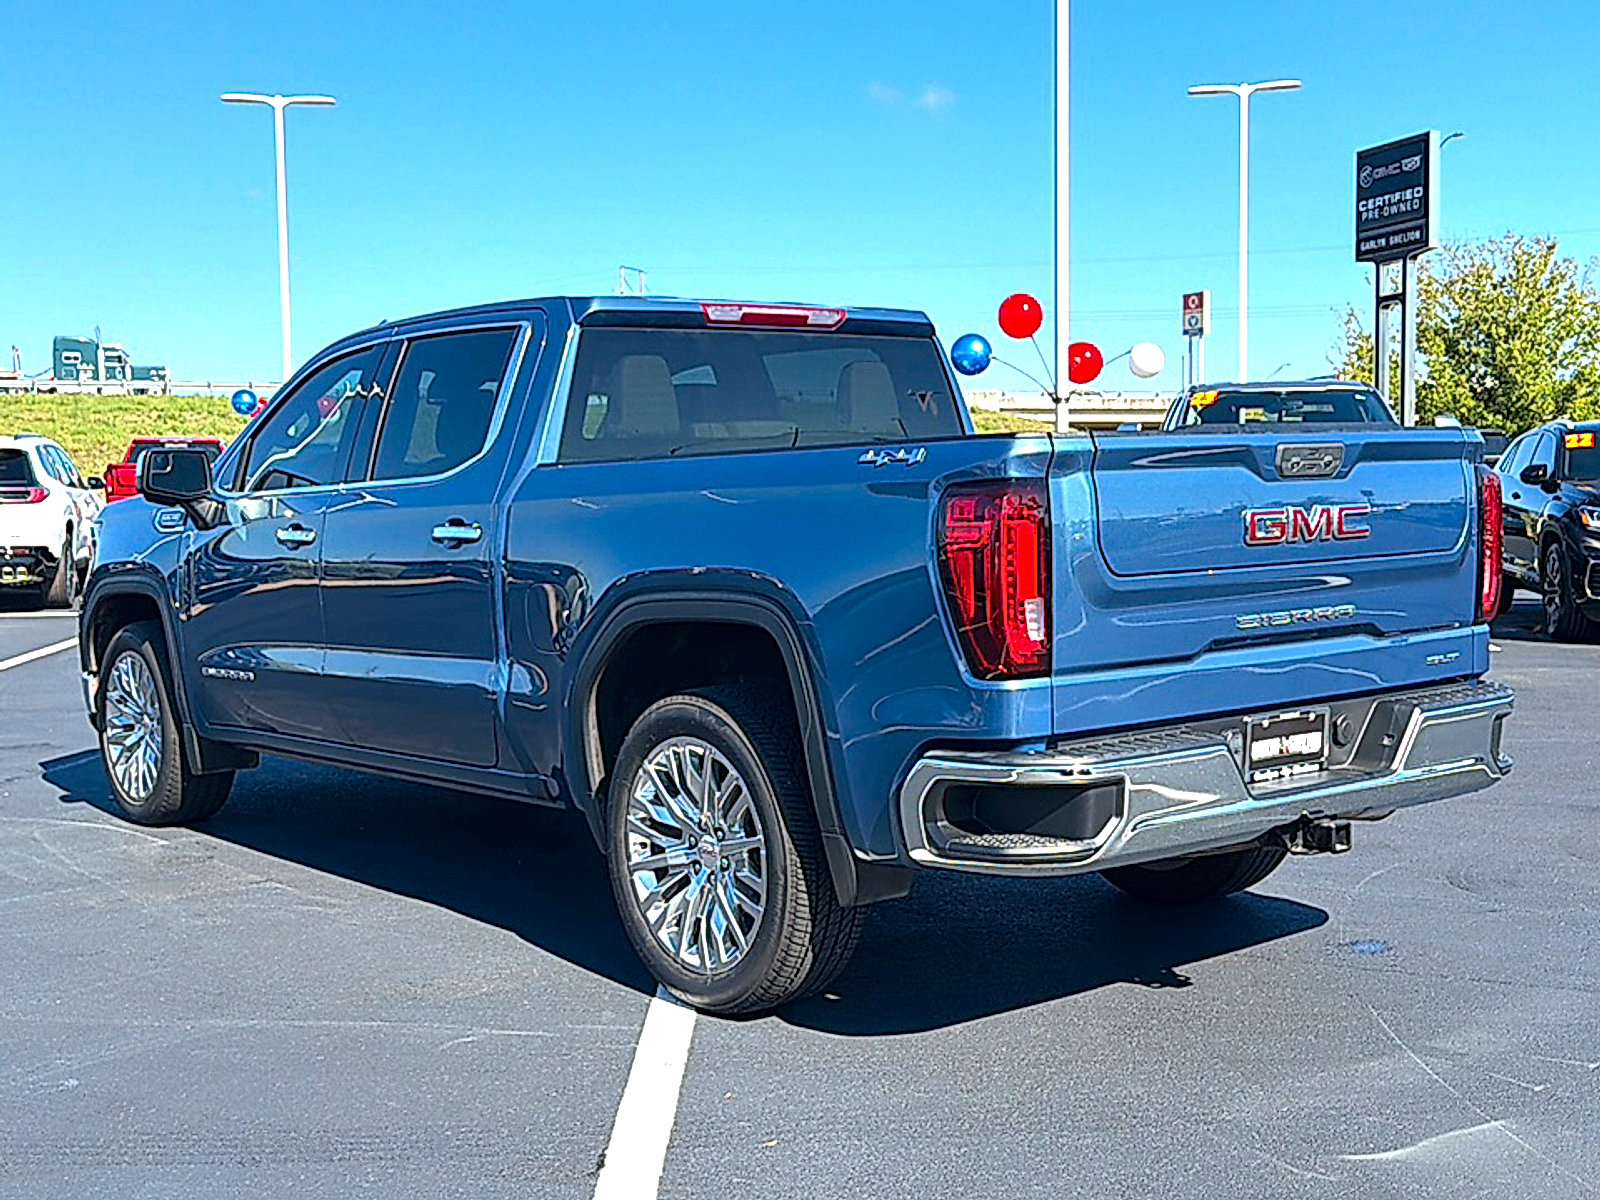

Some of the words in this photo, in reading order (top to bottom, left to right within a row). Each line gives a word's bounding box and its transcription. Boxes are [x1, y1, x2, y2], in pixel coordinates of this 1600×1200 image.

[1358, 186, 1424, 212] CERTIFIED
[1361, 199, 1420, 222] PRE-OWNED
[1244, 502, 1371, 546] GMC
[1236, 604, 1356, 629] SIERRA
